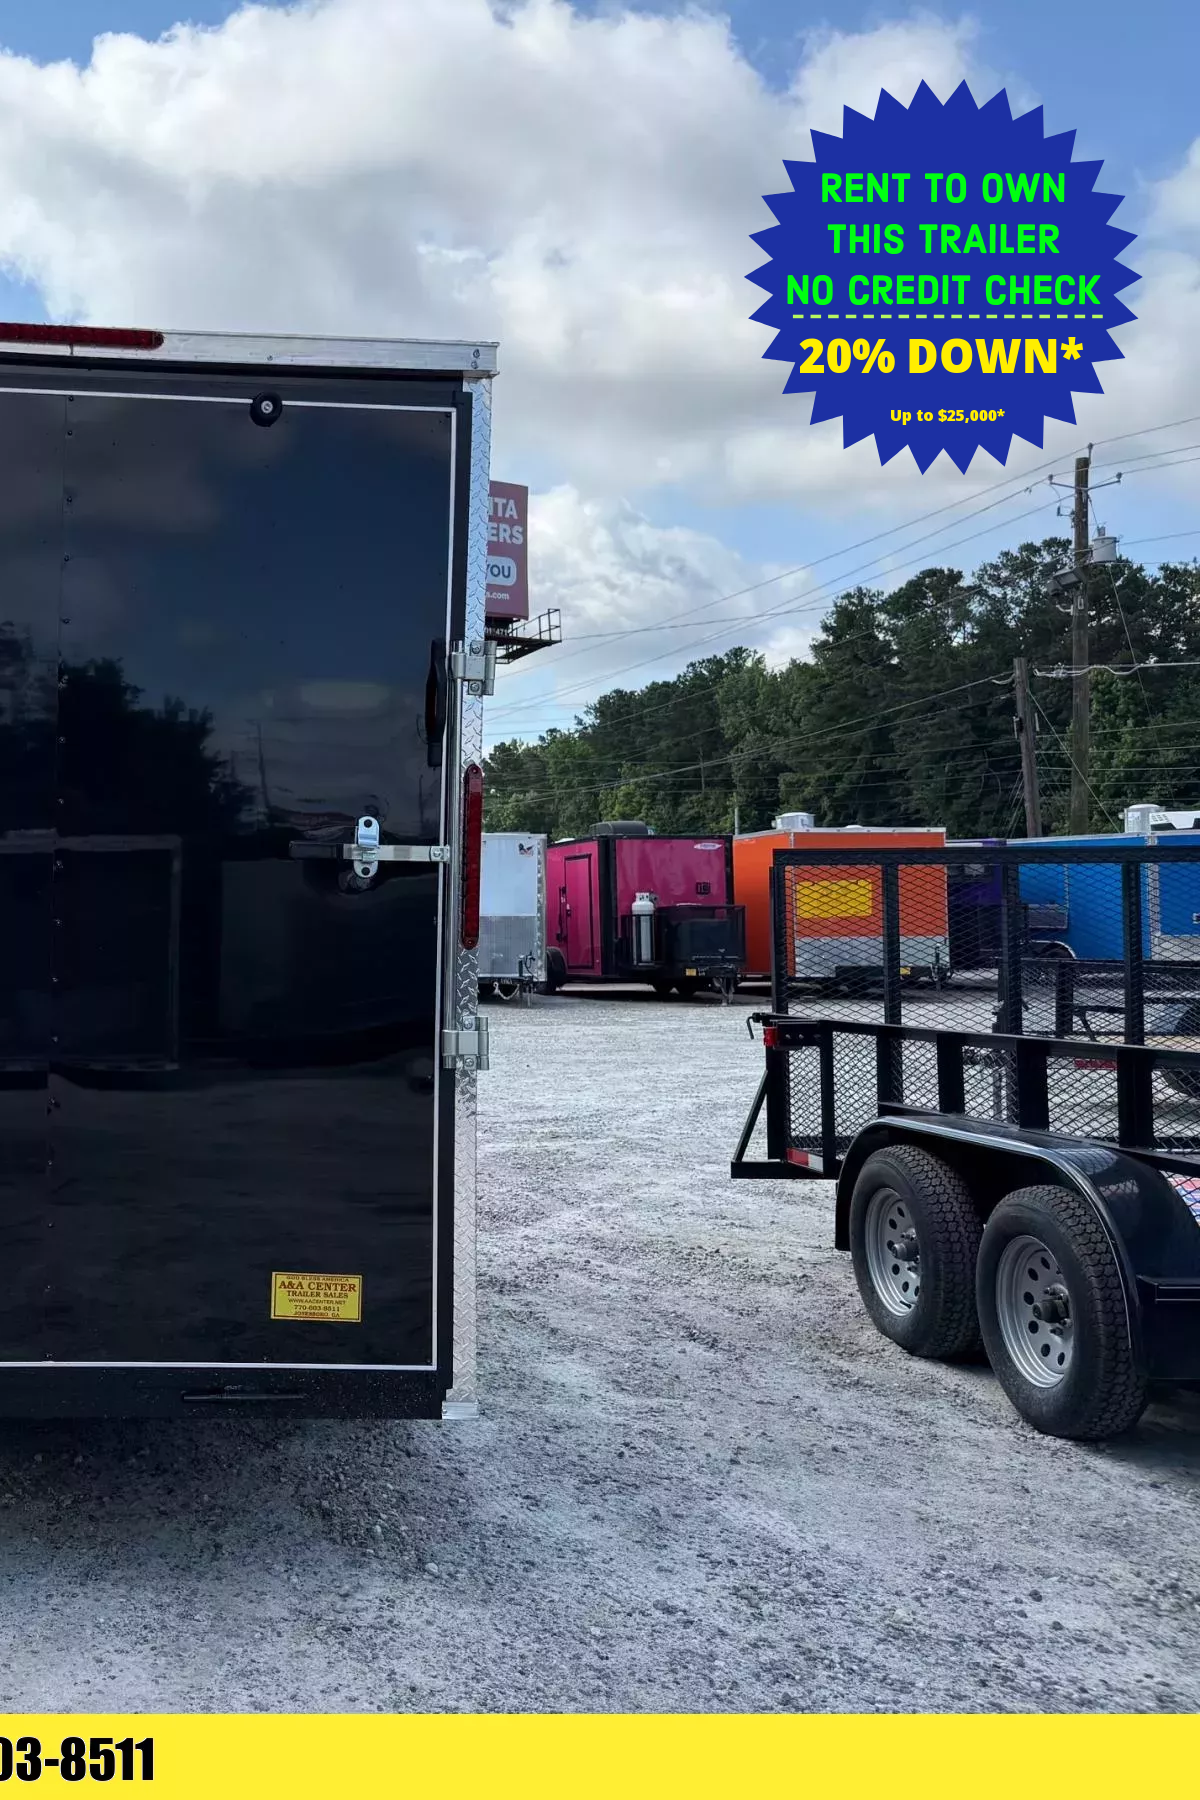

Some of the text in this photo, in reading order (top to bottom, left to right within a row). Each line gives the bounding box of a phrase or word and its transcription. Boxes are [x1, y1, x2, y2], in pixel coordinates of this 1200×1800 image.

[279, 1280, 357, 1292] A&A CENTER
[287, 1290, 349, 1299] TRAILER SALES
